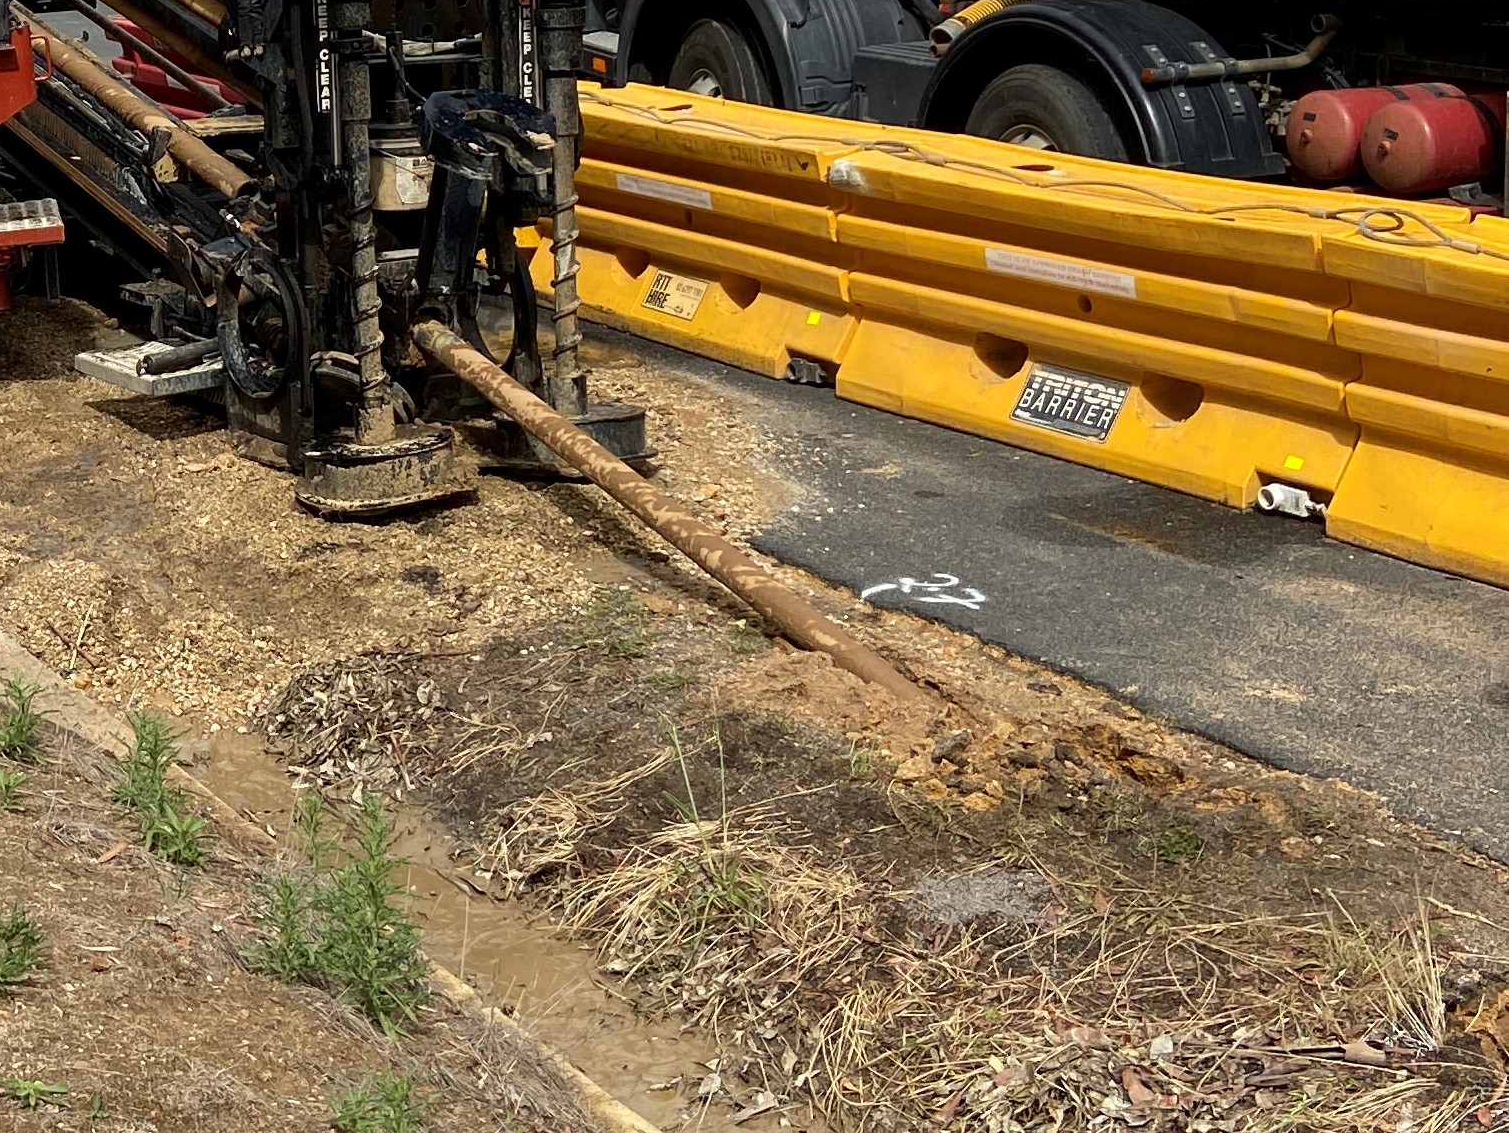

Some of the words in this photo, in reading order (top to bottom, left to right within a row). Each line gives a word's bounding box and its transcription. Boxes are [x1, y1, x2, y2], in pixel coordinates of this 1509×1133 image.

[522, 8, 532, 55] KEEP
[319, 48, 331, 111] CLEAR
[522, 61, 533, 104] CLE
[645, 288, 671, 309] HIRE
[652, 273, 673, 291] RTT
[1018, 388, 1114, 429] BARRIER
[1031, 369, 1127, 409] TRITON
